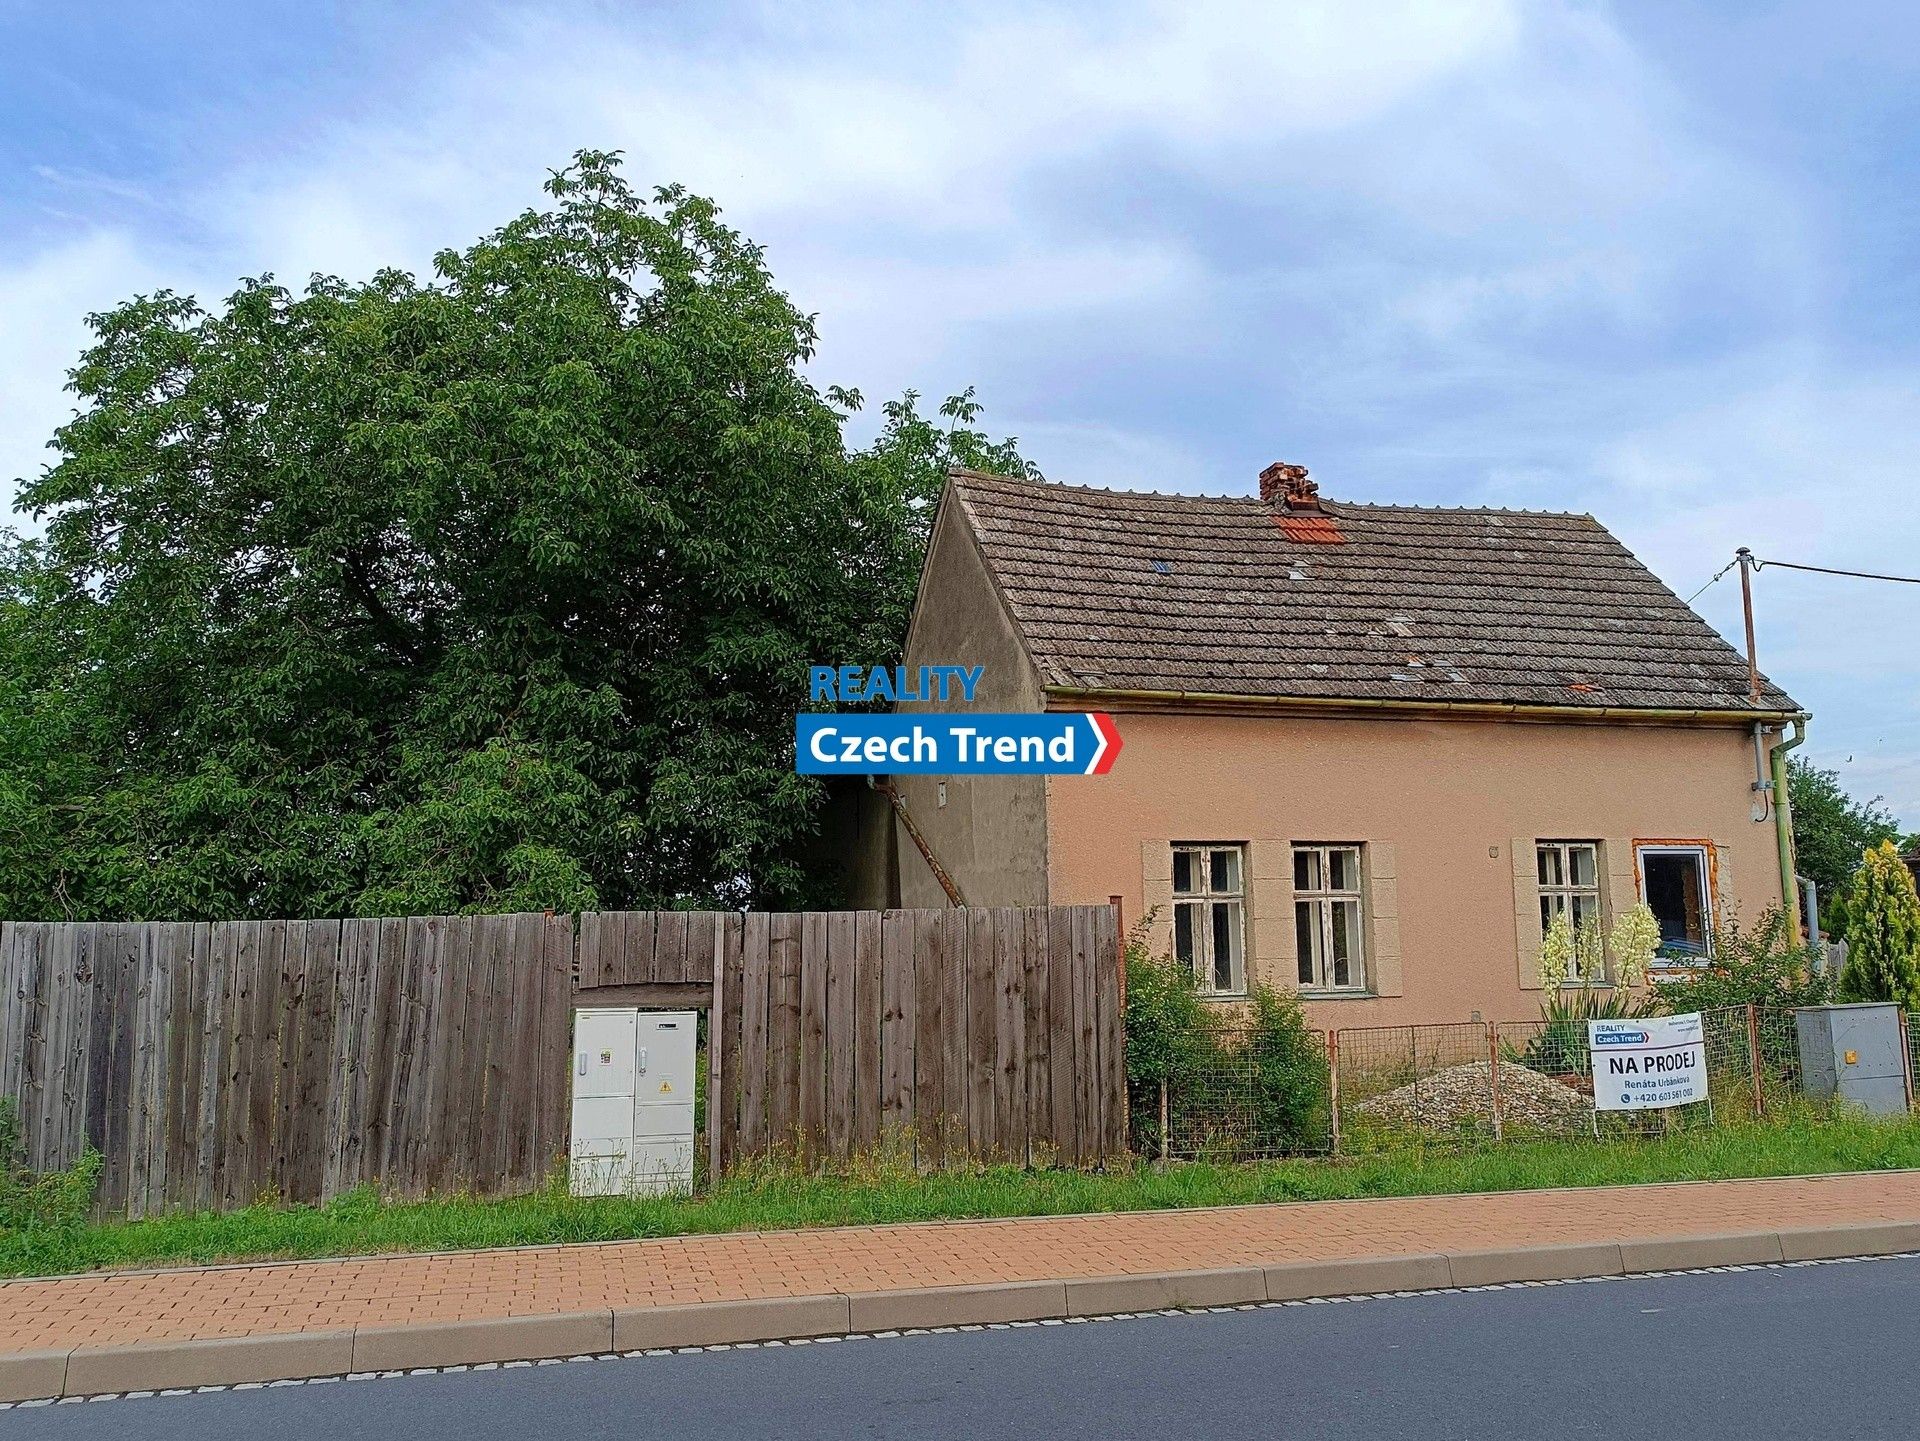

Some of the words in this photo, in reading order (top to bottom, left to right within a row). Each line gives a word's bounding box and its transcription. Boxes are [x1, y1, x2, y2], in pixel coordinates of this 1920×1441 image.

[1596, 1024, 1625, 1032] REALITY
[1597, 1034, 1620, 1043] Czech
[1621, 1033, 1643, 1043] Trend
[1609, 1058, 1639, 1074] NA
[1644, 1051, 1695, 1073] PRODEJ
[1624, 1080, 1657, 1089] Renáta
[1658, 1076, 1690, 1087] Urbánková
[1633, 1094, 1657, 1102] +420
[1659, 1093, 1671, 1101] 603
